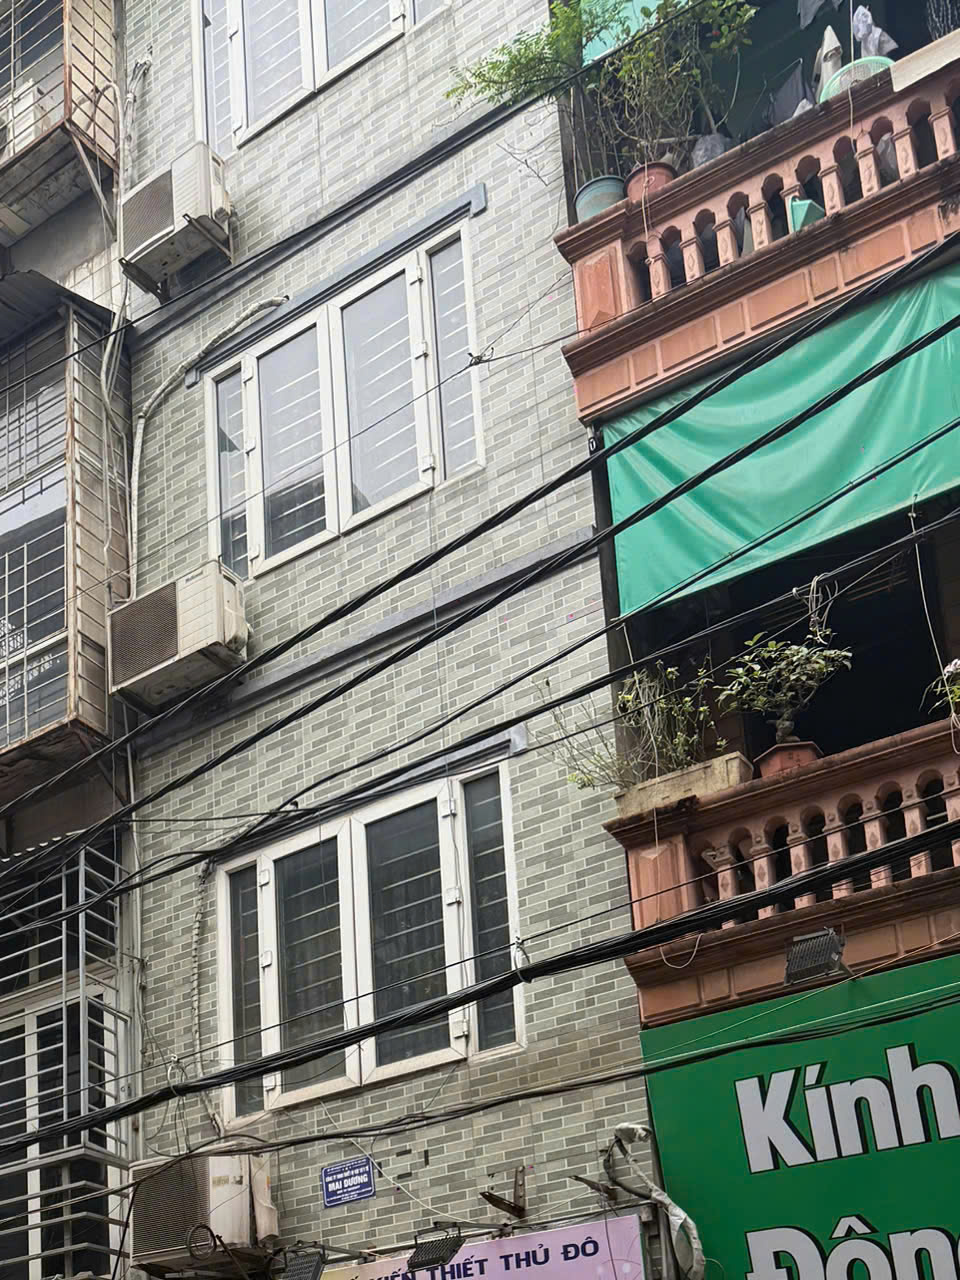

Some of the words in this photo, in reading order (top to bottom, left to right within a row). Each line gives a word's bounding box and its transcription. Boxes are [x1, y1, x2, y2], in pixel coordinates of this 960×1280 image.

[735, 1044, 960, 1174] Kính
[499, 1240, 550, 1271] THỦ
[560, 1235, 600, 1263] ĐÔ
